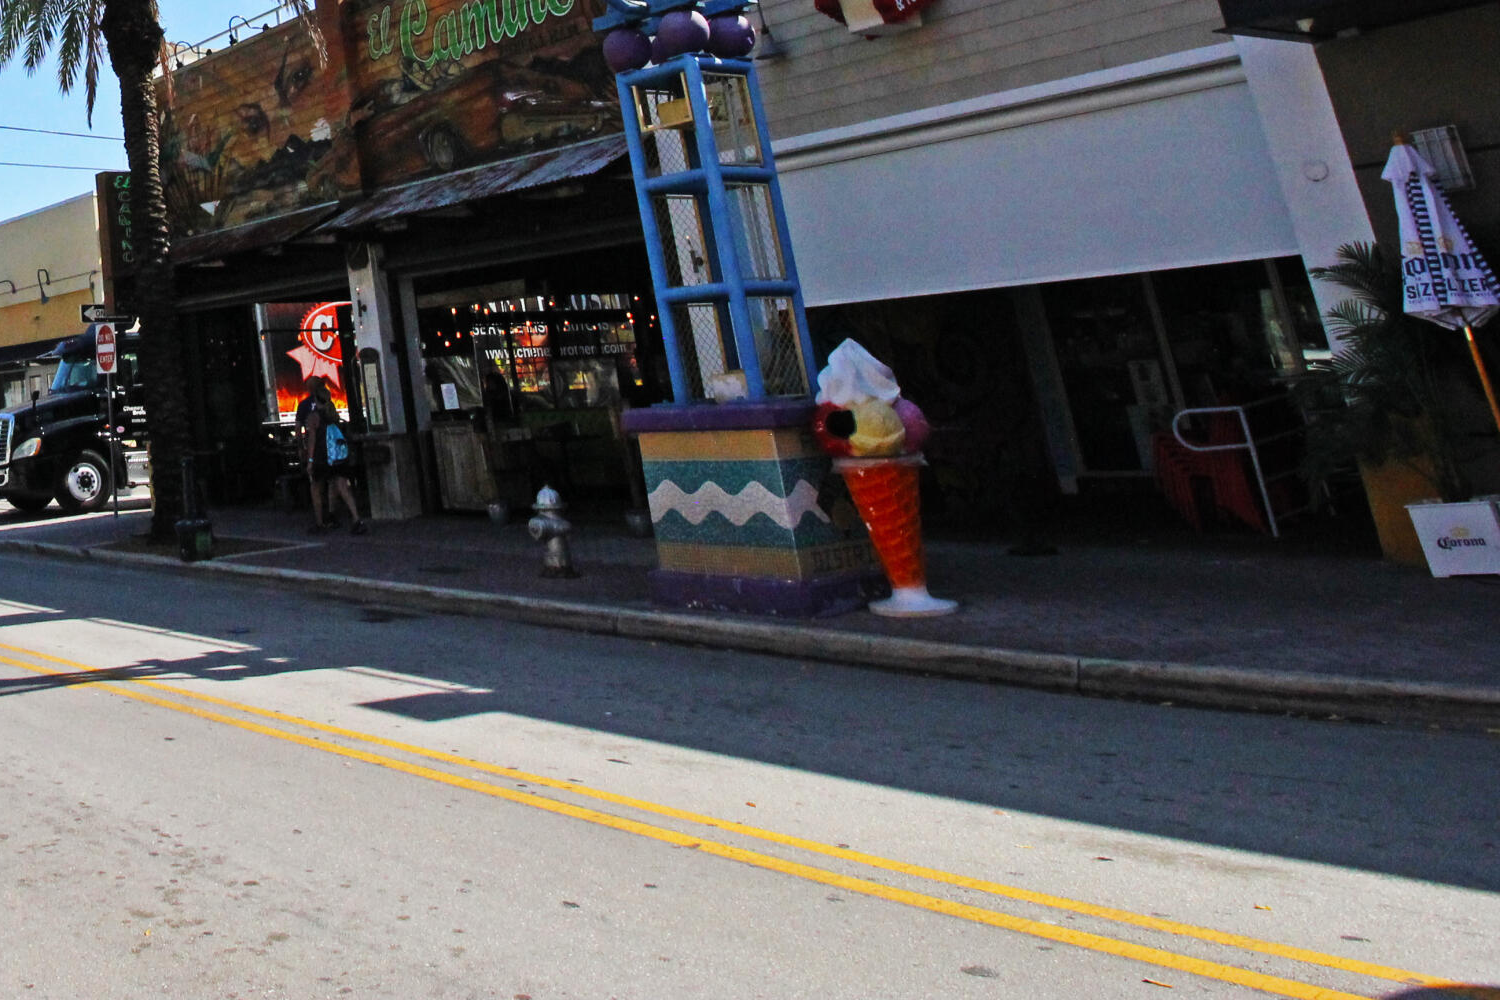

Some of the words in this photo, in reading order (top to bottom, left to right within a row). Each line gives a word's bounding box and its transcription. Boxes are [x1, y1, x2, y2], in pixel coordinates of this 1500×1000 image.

[366, 5, 394, 61] El
[100, 355, 113, 363] ENTER
[1436, 536, 1487, 551] Corona
